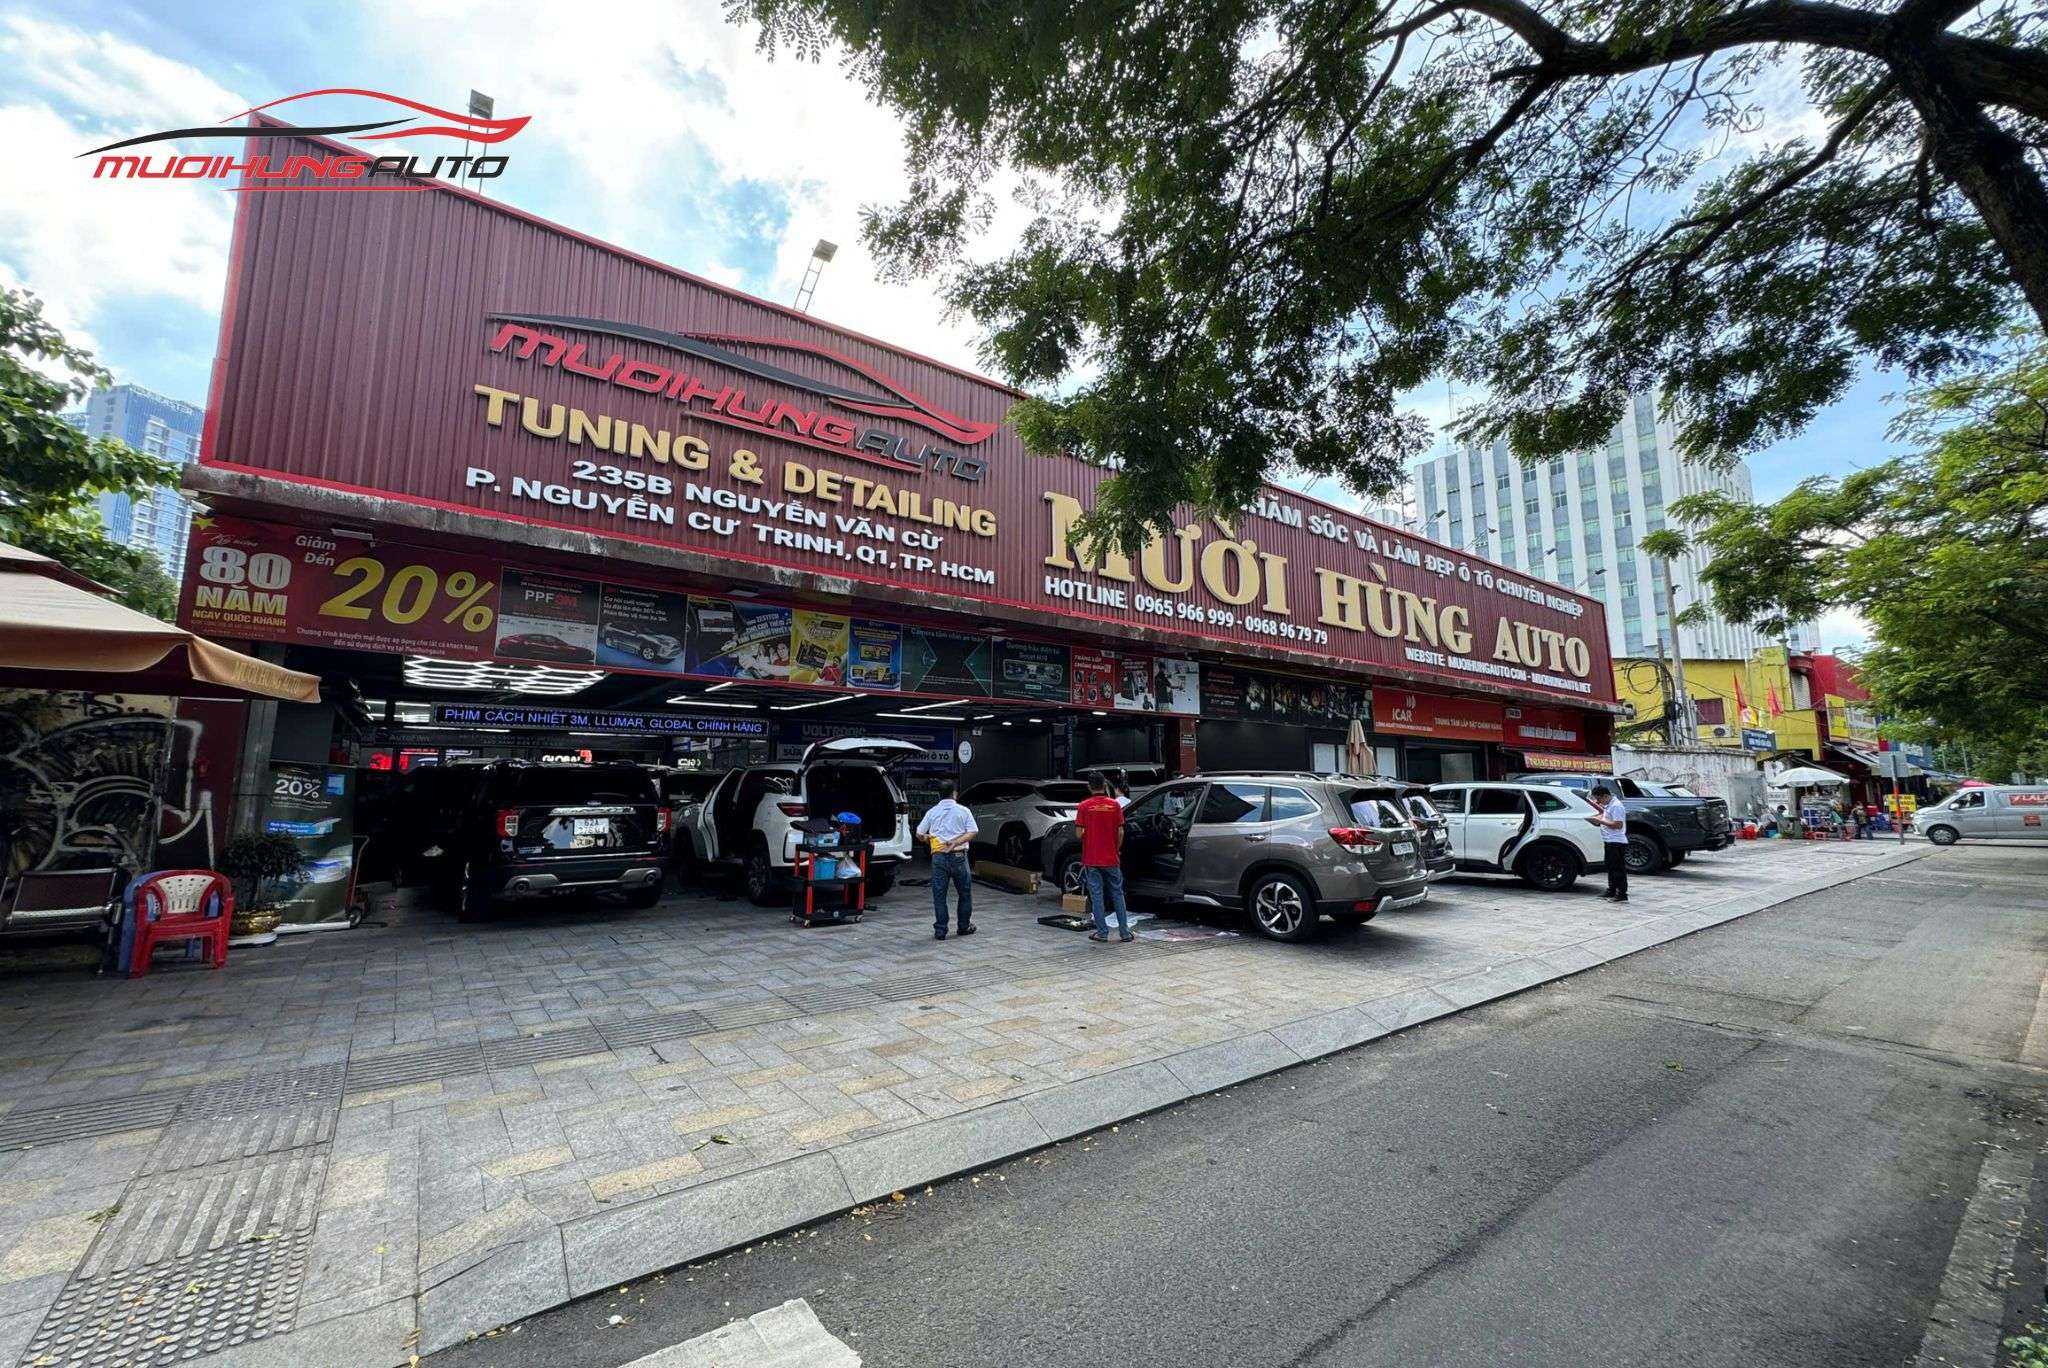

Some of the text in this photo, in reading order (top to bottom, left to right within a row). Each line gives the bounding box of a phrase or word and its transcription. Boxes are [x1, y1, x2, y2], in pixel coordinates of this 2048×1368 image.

[474, 384, 997, 537] TUNING & DETAILING
[465, 466, 501, 493] P.
[511, 476, 675, 527] NGUYỄN
[687, 511, 741, 537] CƯ
[941, 560, 995, 585] HCM
[572, 459, 944, 551] 235B NGUYỄN VĂN CỪ
[295, 534, 337, 551] Giảm
[304, 551, 336, 567] Đến
[200, 546, 293, 590] 80
[1307, 514, 1349, 543] SÓC
[1354, 529, 1379, 554] VÀ
[1383, 540, 1420, 568] LÀM
[1424, 554, 1455, 579] ĐẸP
[1458, 562, 1471, 582] Ô
[1473, 569, 1494, 590] TÔ
[1496, 578, 1545, 606] CHUYÊN
[1546, 594, 1584, 620] NGHIỆP
[195, 584, 289, 616] NĂM
[318, 557, 495, 633] 20%
[525, 590, 554, 603] PPF
[1134, 594, 1174, 617] 0965
[1176, 602, 1205, 623] 966
[1207, 609, 1235, 628] 999
[1245, 616, 1278, 637] 0968
[1313, 629, 1328, 645] 79
[1314, 561, 1474, 655] HÙNG
[1493, 616, 1591, 678] AUTO
[445, 709, 480, 721] PHIM
[484, 709, 522, 722] CÁCH
[649, 718, 694, 730] GLOBAL
[696, 717, 730, 732] CHÍNH
[274, 779, 321, 799] 20%
